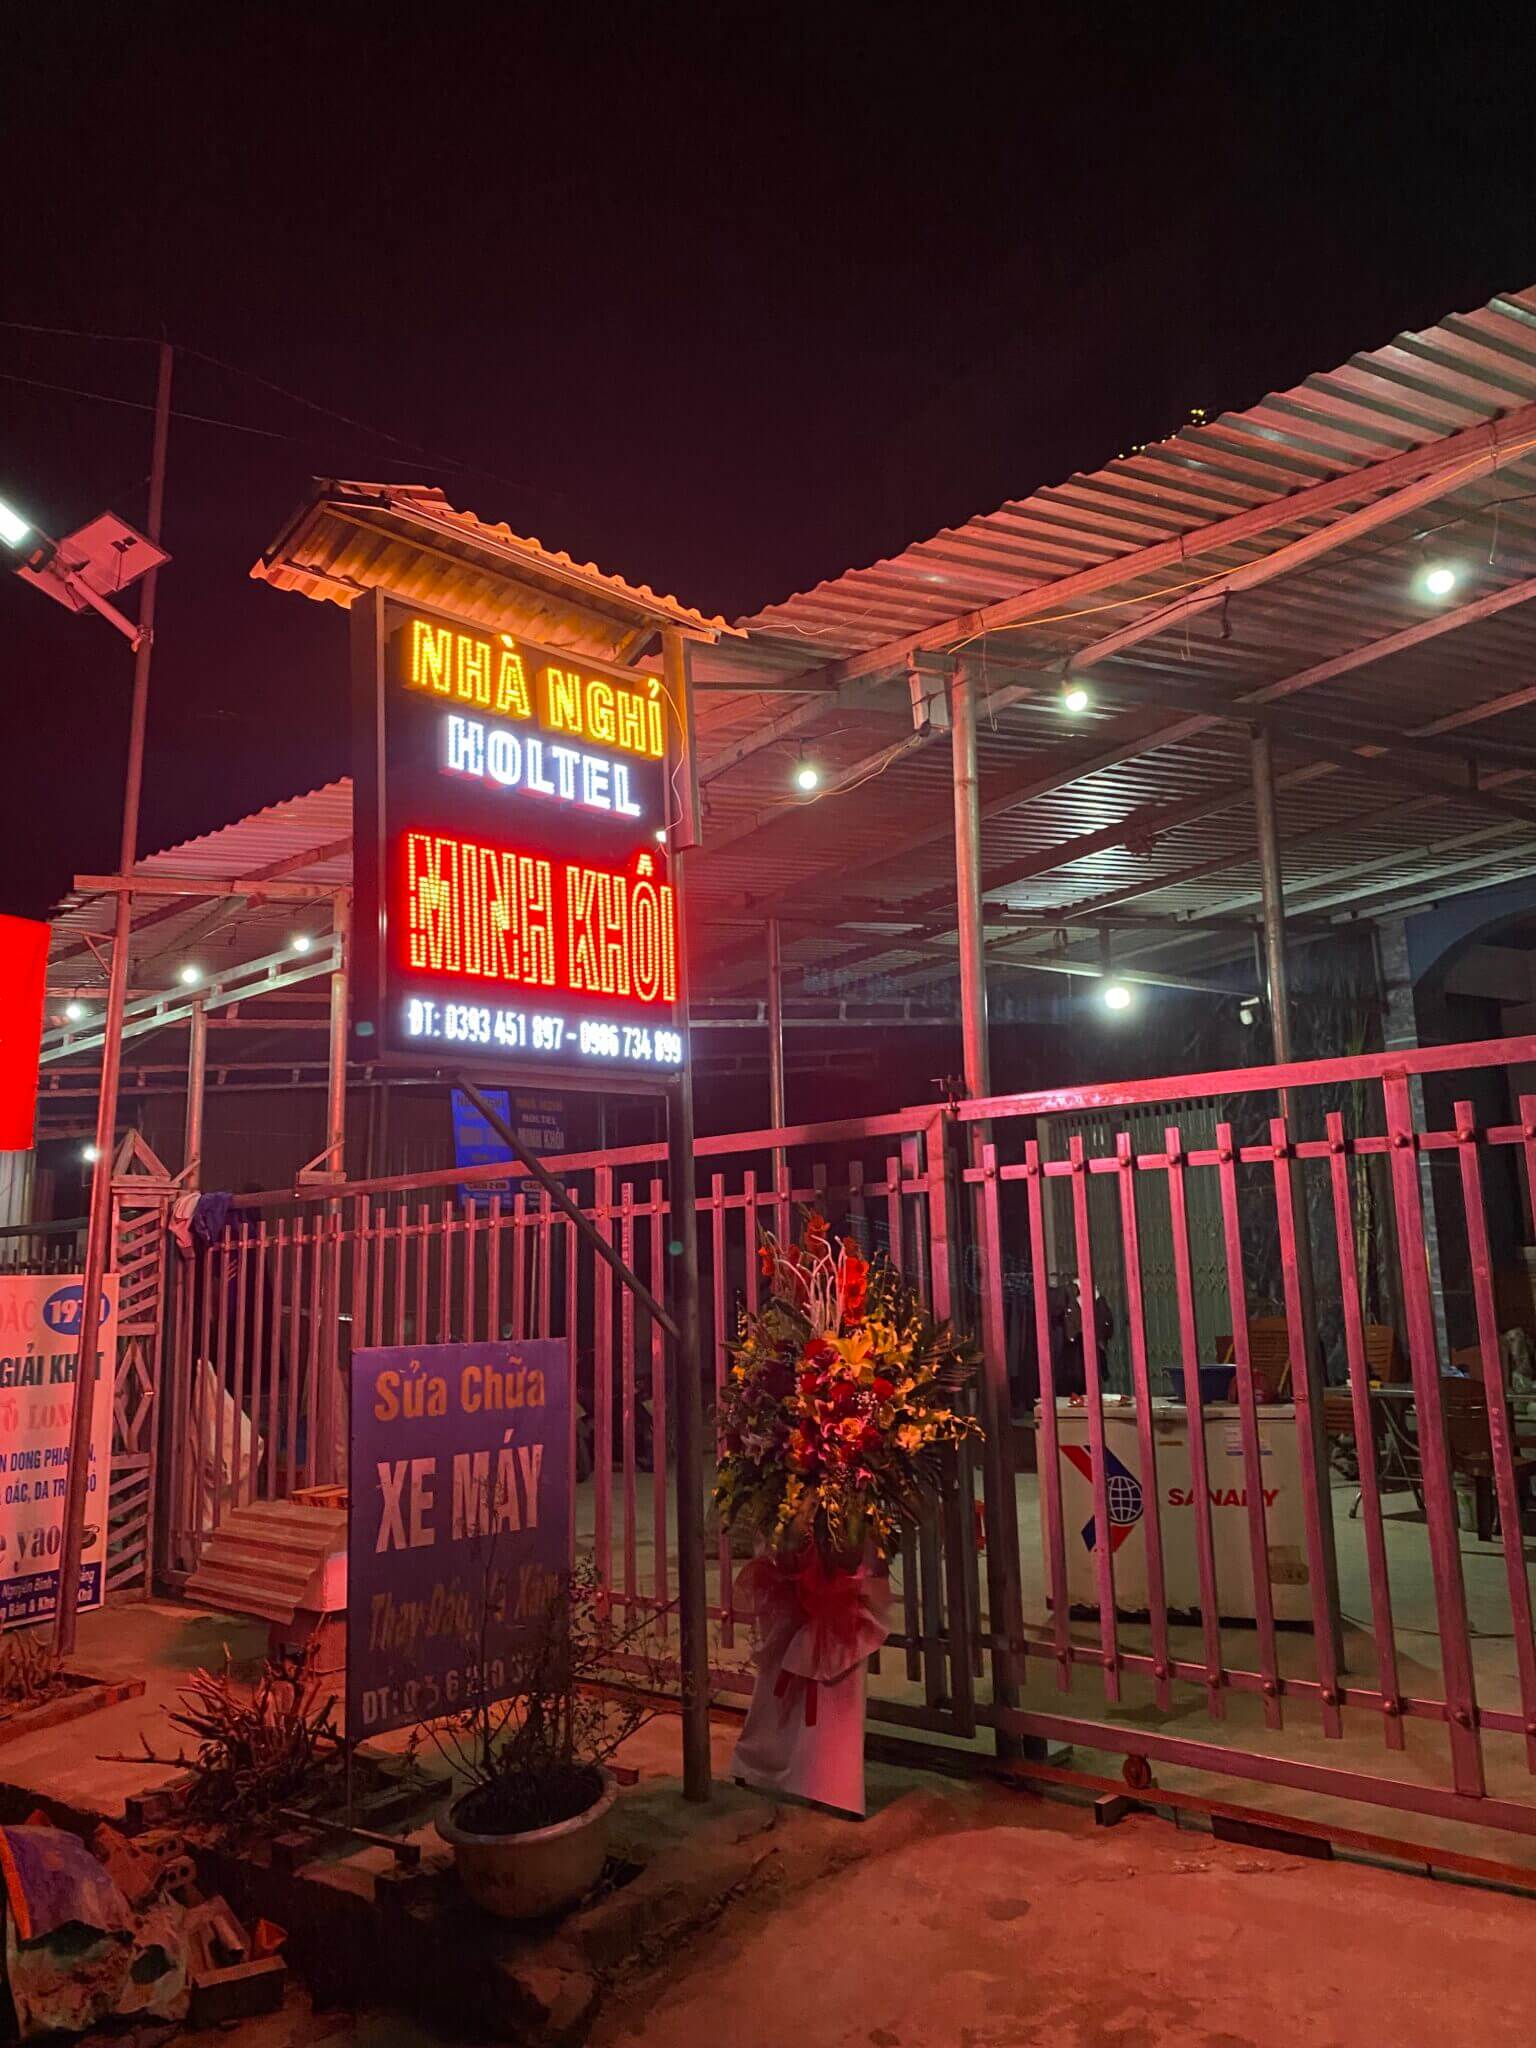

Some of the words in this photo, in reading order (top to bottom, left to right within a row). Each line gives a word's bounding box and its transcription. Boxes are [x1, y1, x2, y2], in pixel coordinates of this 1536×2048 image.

[413, 620, 531, 718] NHÀ
[547, 668, 664, 758] NGHỈ
[447, 715, 641, 817] HOLTEL
[409, 833, 556, 986] MINH
[566, 854, 677, 1002] KHÔI
[446, 1004, 491, 1043] 0393
[494, 1010, 526, 1047] 451
[532, 1015, 564, 1050] 897
[622, 1026, 653, 1060] 734
[0, 1343, 44, 1388] GIẢI
[50, 1352, 104, 1384] KHT
[374, 1359, 448, 1422] Sửa
[460, 1355, 546, 1414] Chữa
[10, 1450, 41, 1472] DONG
[375, 1457, 437, 1554] XE
[452, 1428, 544, 1541] MÁY
